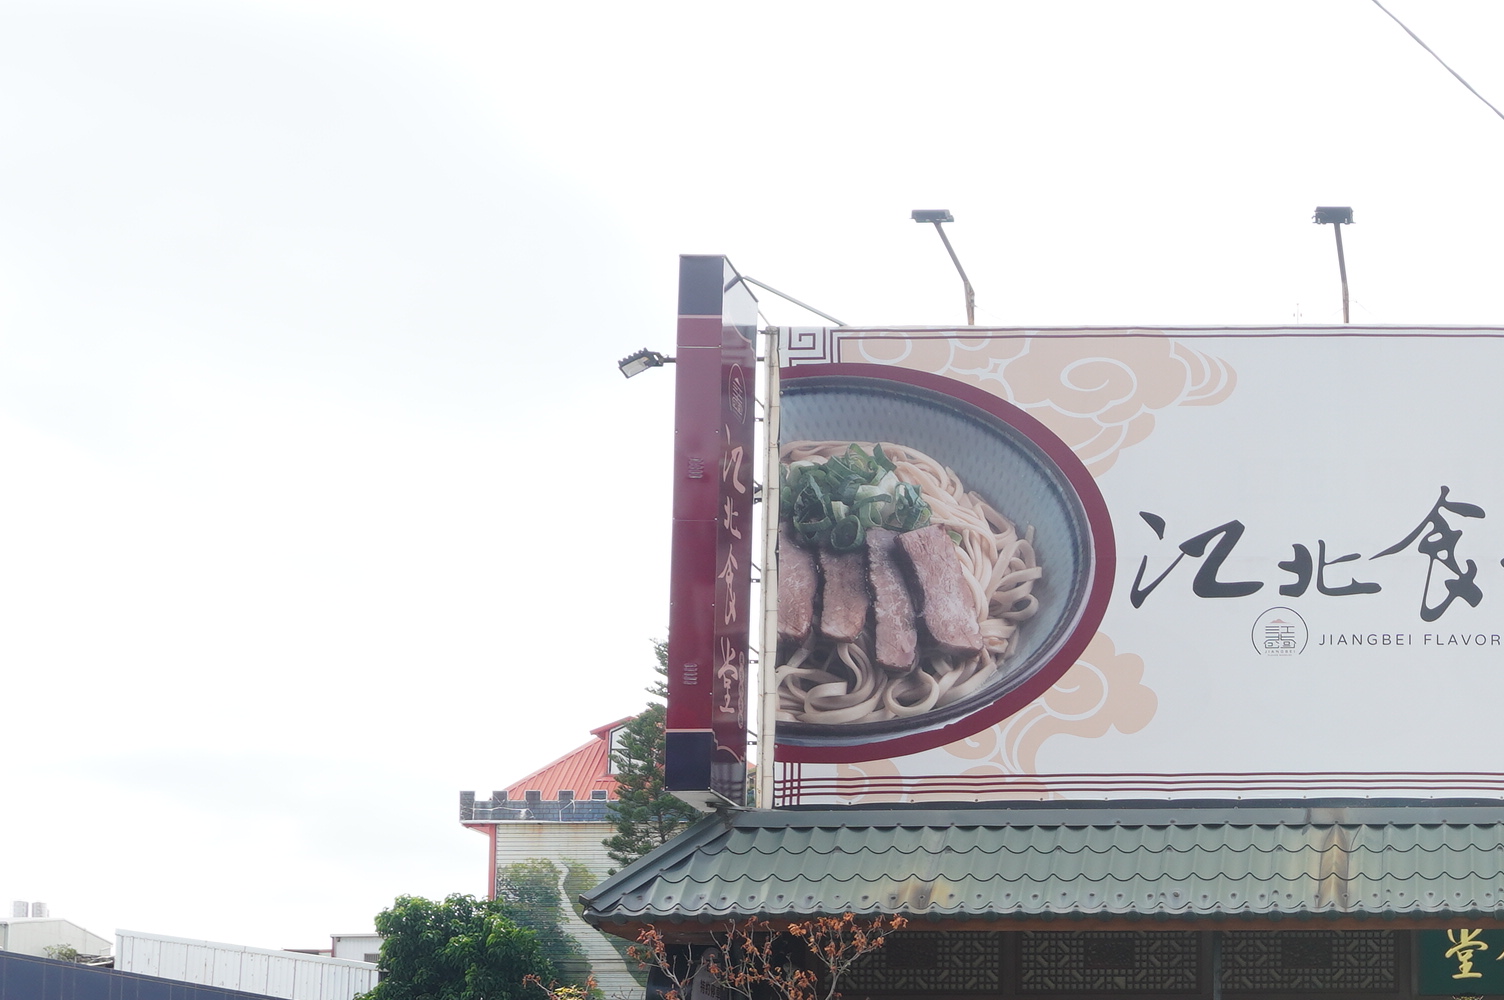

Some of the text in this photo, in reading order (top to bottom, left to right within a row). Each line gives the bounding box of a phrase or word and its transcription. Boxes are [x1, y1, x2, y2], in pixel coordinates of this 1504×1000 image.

[718, 424, 746, 713] 江北食堂
[1319, 633, 1412, 646] JIANGBEI
[1424, 633, 1501, 646] FLAVOR
